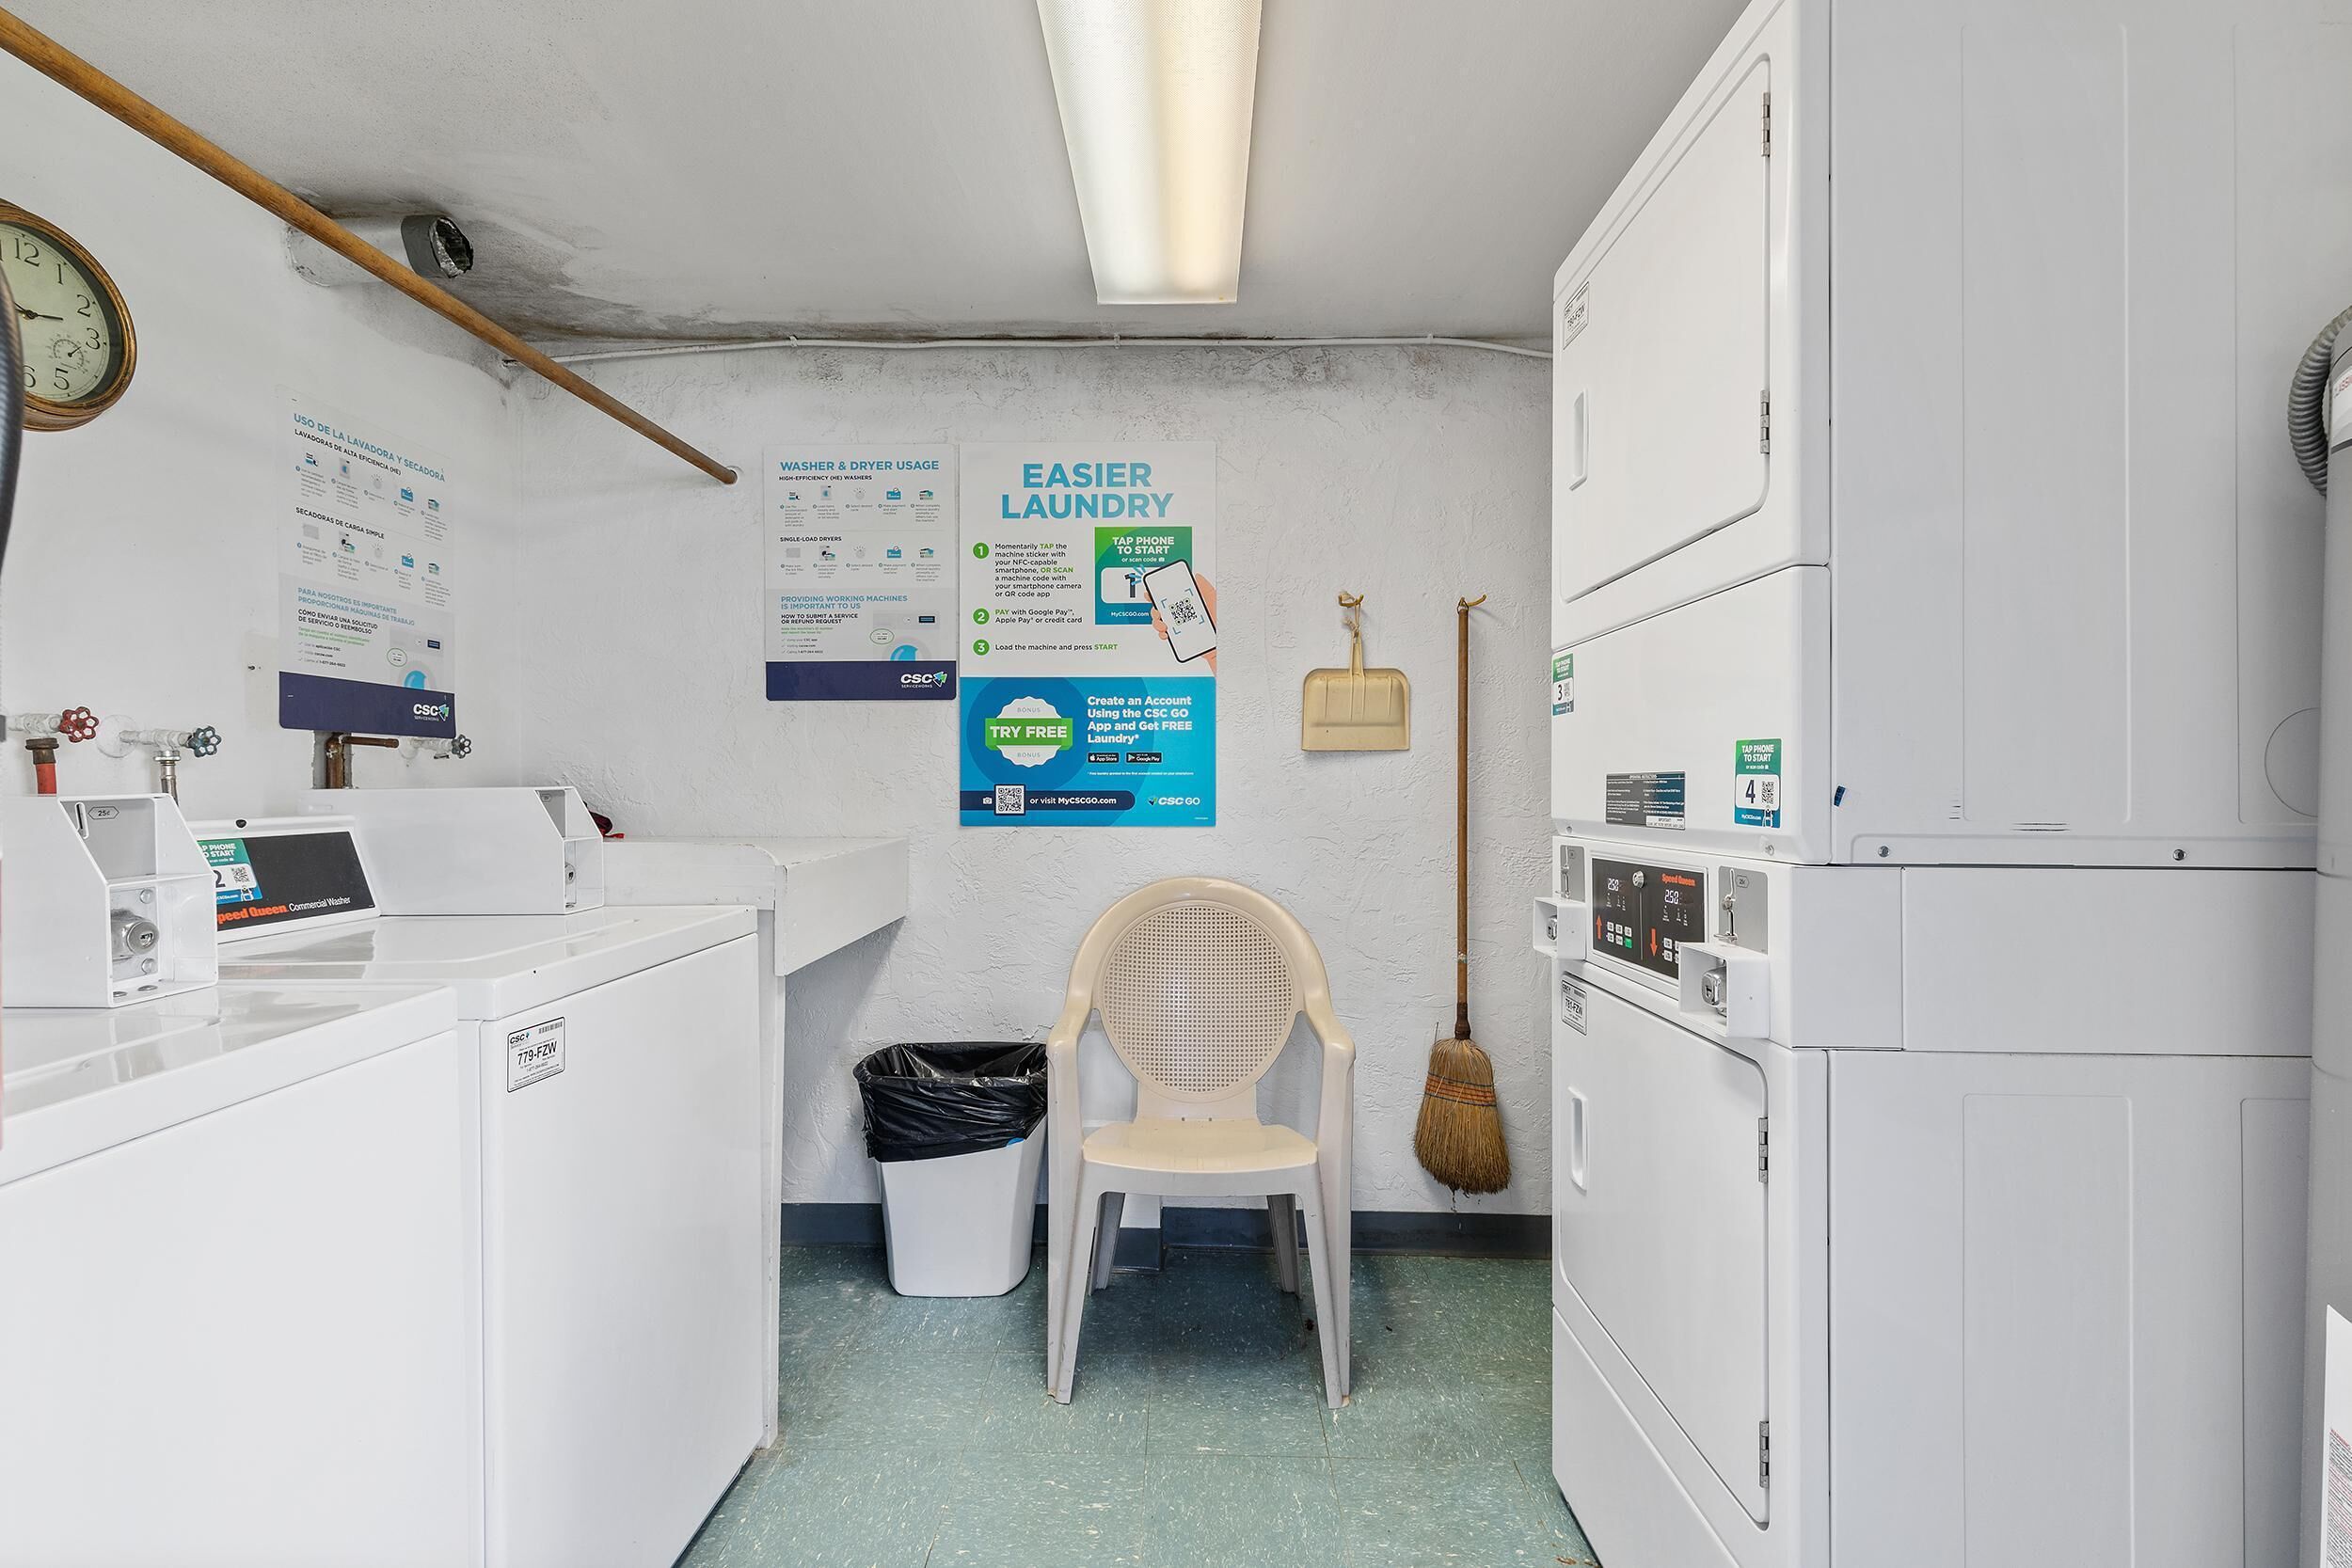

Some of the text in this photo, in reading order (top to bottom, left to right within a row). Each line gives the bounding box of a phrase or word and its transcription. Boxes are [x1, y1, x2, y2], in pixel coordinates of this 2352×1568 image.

[15, 238, 40, 267] 12
[56, 263, 64, 285] 1
[76, 294, 92, 317] 2
[86, 327, 101, 350] 3
[54, 368, 70, 390] 5
[294, 413, 445, 482] USO DE LA LAVADORA Y SECADORA
[294, 428, 401, 475] LAVADORAS DE ALTA EFICIENCIA (HE)
[780, 460, 939, 471] WASHER & DRYER USAGE
[1023, 462, 1152, 488] EASIER
[1001, 492, 1174, 519] LAUNDRY
[296, 507, 384, 539] SECADORAS DE CARGA SIMPLE
[995, 543, 1038, 551] Momentarily
[1112, 537, 1175, 546] TAP PHONE
[1117, 546, 1170, 555] TO START
[298, 587, 317, 598] PARA
[318, 592, 352, 604] NOSOTROS
[362, 601, 397, 615] IMPORTANTE
[298, 596, 349, 612] PROPORCIONAR
[390, 615, 414, 626] TRABAJO
[977, 612, 985, 621] 2
[308, 618, 334, 628] SERVICIO
[341, 623, 372, 634] REEMBOLSO
[318, 613, 338, 622] ENVIAR
[352, 618, 378, 629] SOLICITUD
[977, 643, 985, 652] 3
[901, 673, 932, 683] CSC
[1088, 696, 1125, 705] Create
[1144, 696, 1192, 705] Account
[1558, 684, 1563, 701] 3
[413, 704, 439, 715] CSC
[1088, 709, 1189, 720] Using the CSC GO
[990, 726, 1067, 738] TRY FREE
[1088, 721, 1192, 733] App and Get FREE
[1754, 744, 1774, 753] PHONE
[1746, 780, 1756, 804] 4
[213, 870, 226, 888] 2
[1661, 873, 1696, 887] Speed Queen
[217, 896, 350, 924] peed Queen Commercial Washer
[510, 1033, 525, 1044] CSC
